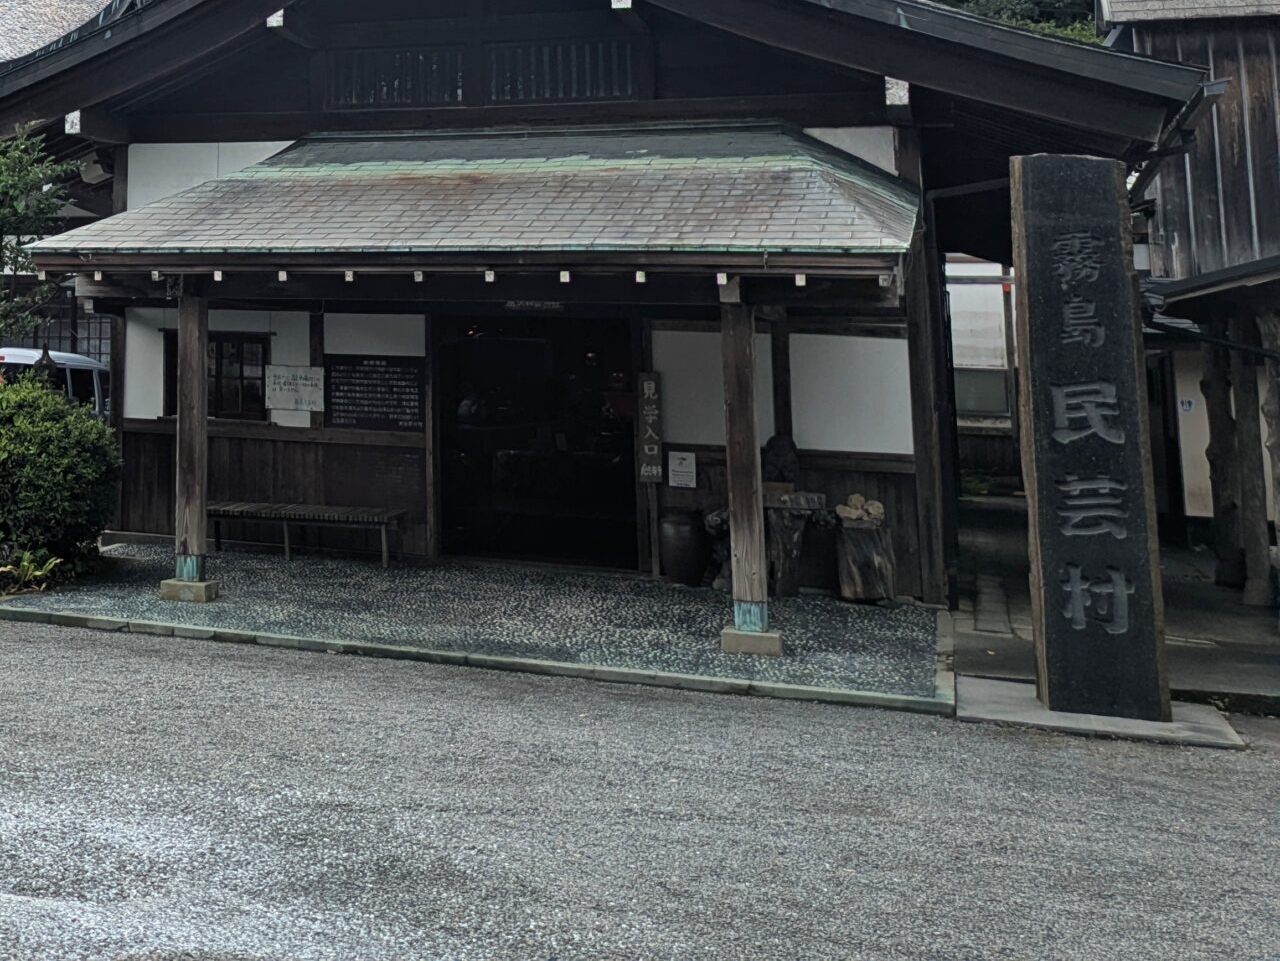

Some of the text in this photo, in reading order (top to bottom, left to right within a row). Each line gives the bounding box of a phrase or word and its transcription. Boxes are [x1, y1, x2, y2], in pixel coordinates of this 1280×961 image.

[643, 381, 659, 455] 見学入口
[1049, 231, 1135, 635] 霧島民芸村
